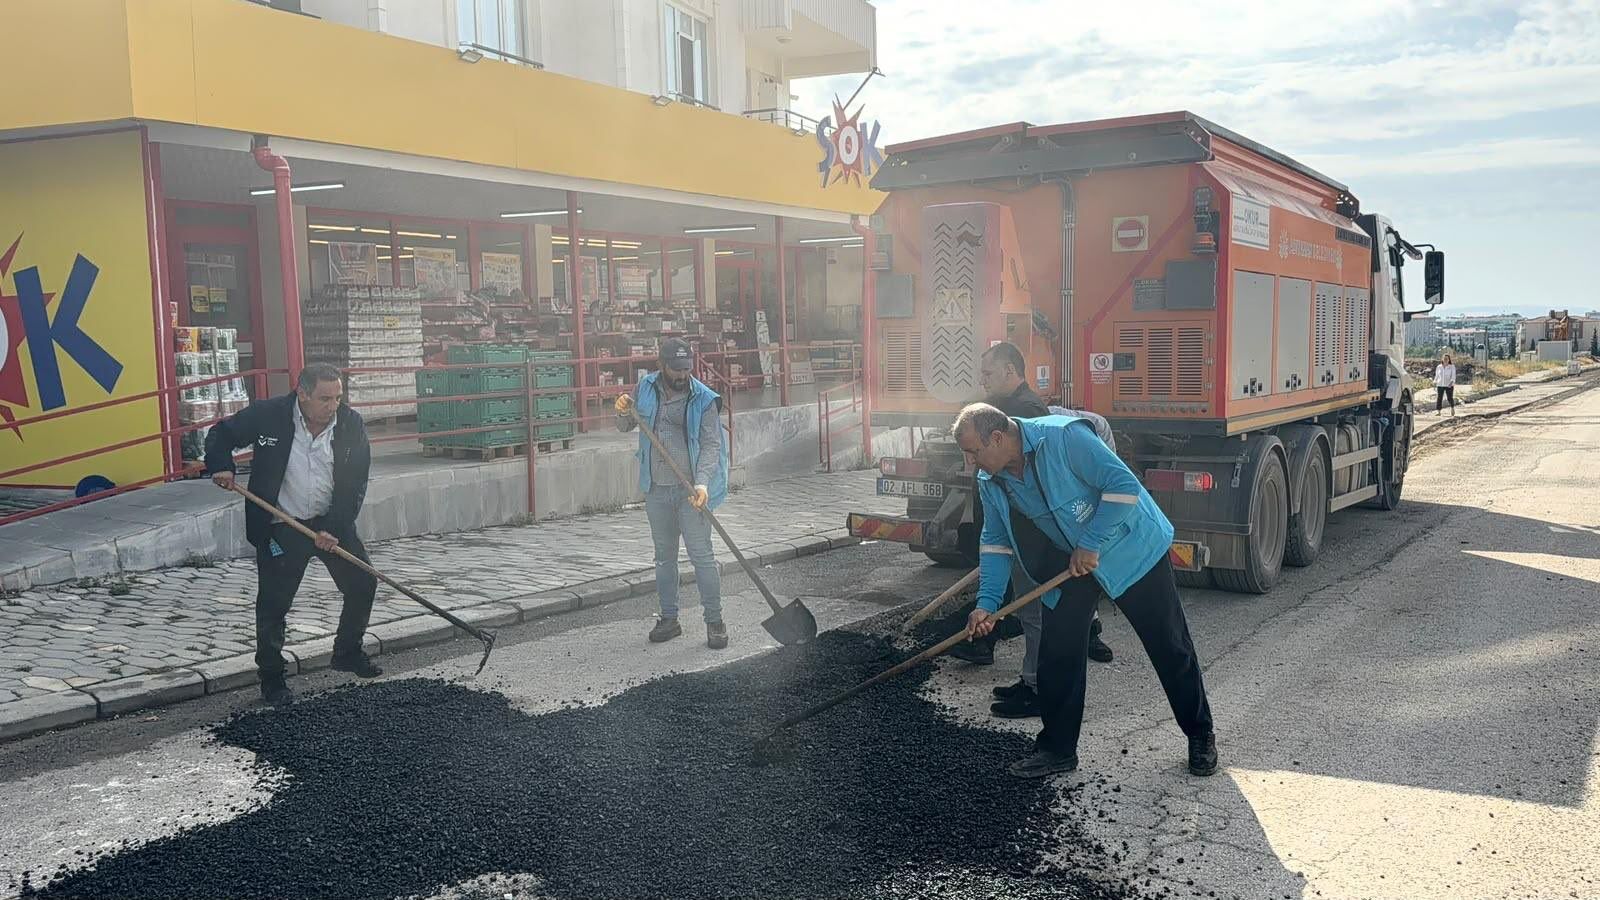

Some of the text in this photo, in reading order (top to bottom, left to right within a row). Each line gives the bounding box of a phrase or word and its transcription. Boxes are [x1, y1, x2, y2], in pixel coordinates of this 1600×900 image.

[883, 480, 942, 497] 02 AFL 968
